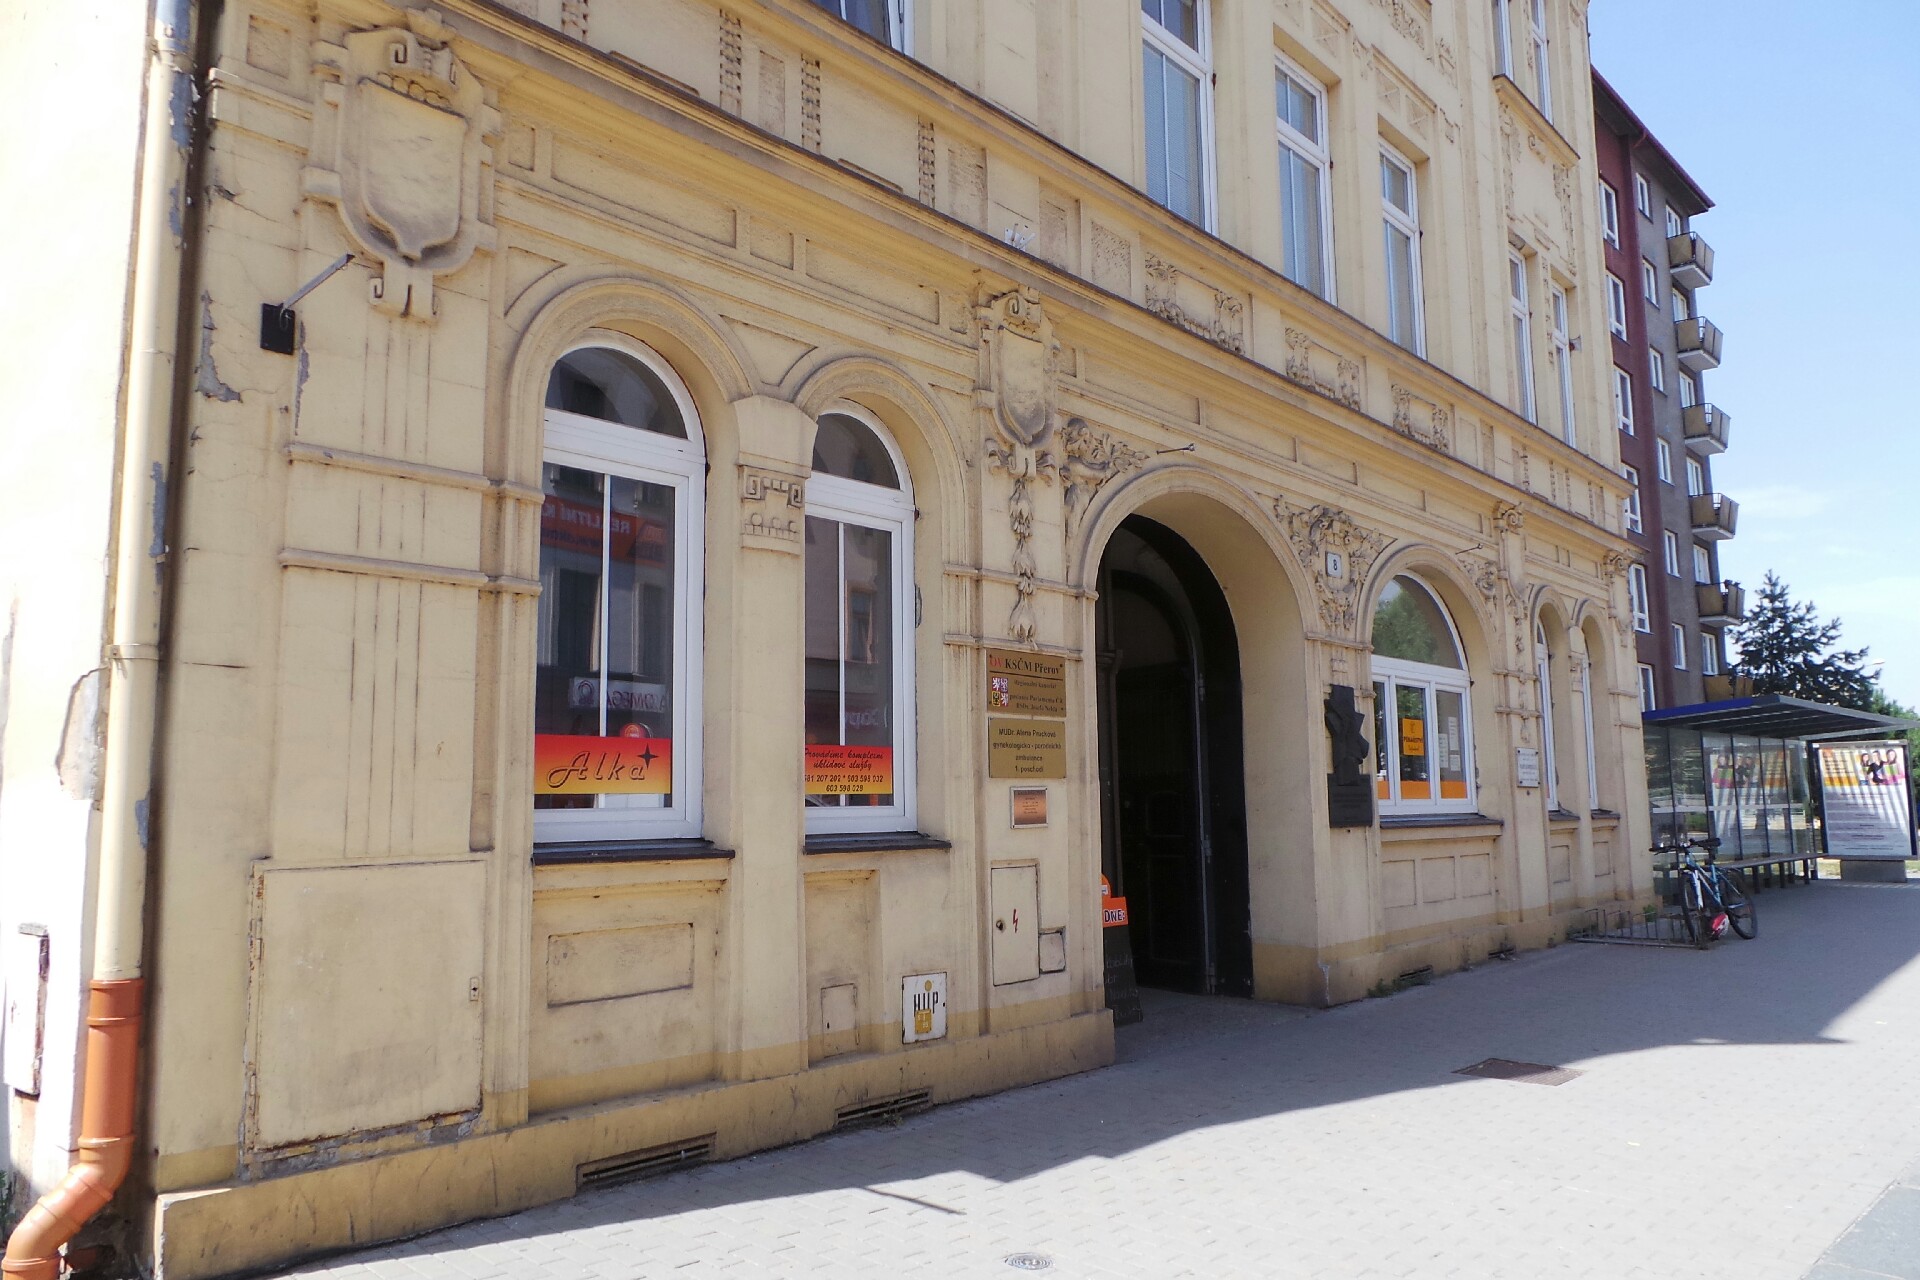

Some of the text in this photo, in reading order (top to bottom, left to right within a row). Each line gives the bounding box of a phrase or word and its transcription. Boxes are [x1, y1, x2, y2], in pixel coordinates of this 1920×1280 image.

[1005, 658, 1032, 672] KSČM
[1034, 662, 1059, 675] Přerov
[547, 751, 645, 788] Alka
[816, 774, 829, 783] 207
